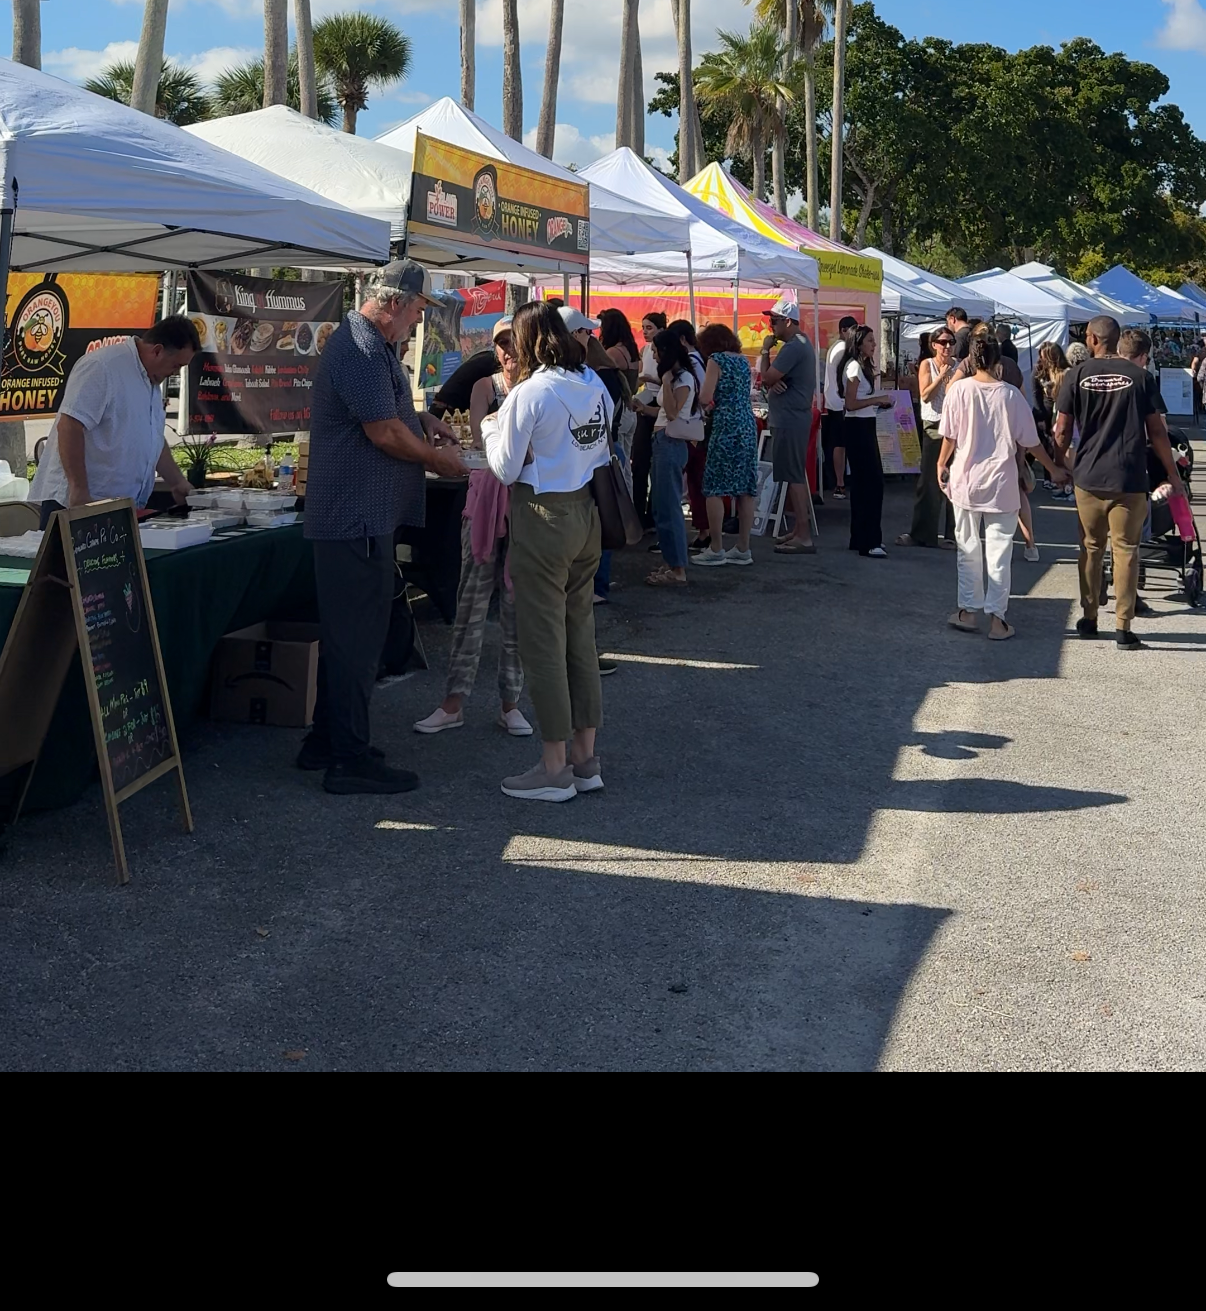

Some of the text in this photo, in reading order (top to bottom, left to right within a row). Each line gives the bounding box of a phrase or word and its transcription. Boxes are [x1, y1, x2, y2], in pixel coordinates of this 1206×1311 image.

[429, 202, 455, 220] POWER
[501, 201, 539, 220] ORANGE INFUSED
[502, 213, 540, 242] HONEY
[234, 285, 256, 313] King
[265, 289, 306, 310] Hummus
[22, 297, 61, 322] ORANGEYOU
[1, 377, 59, 389] ORANGE INFUSED
[0, 389, 58, 410] HONEY
[577, 424, 603, 440] surf
